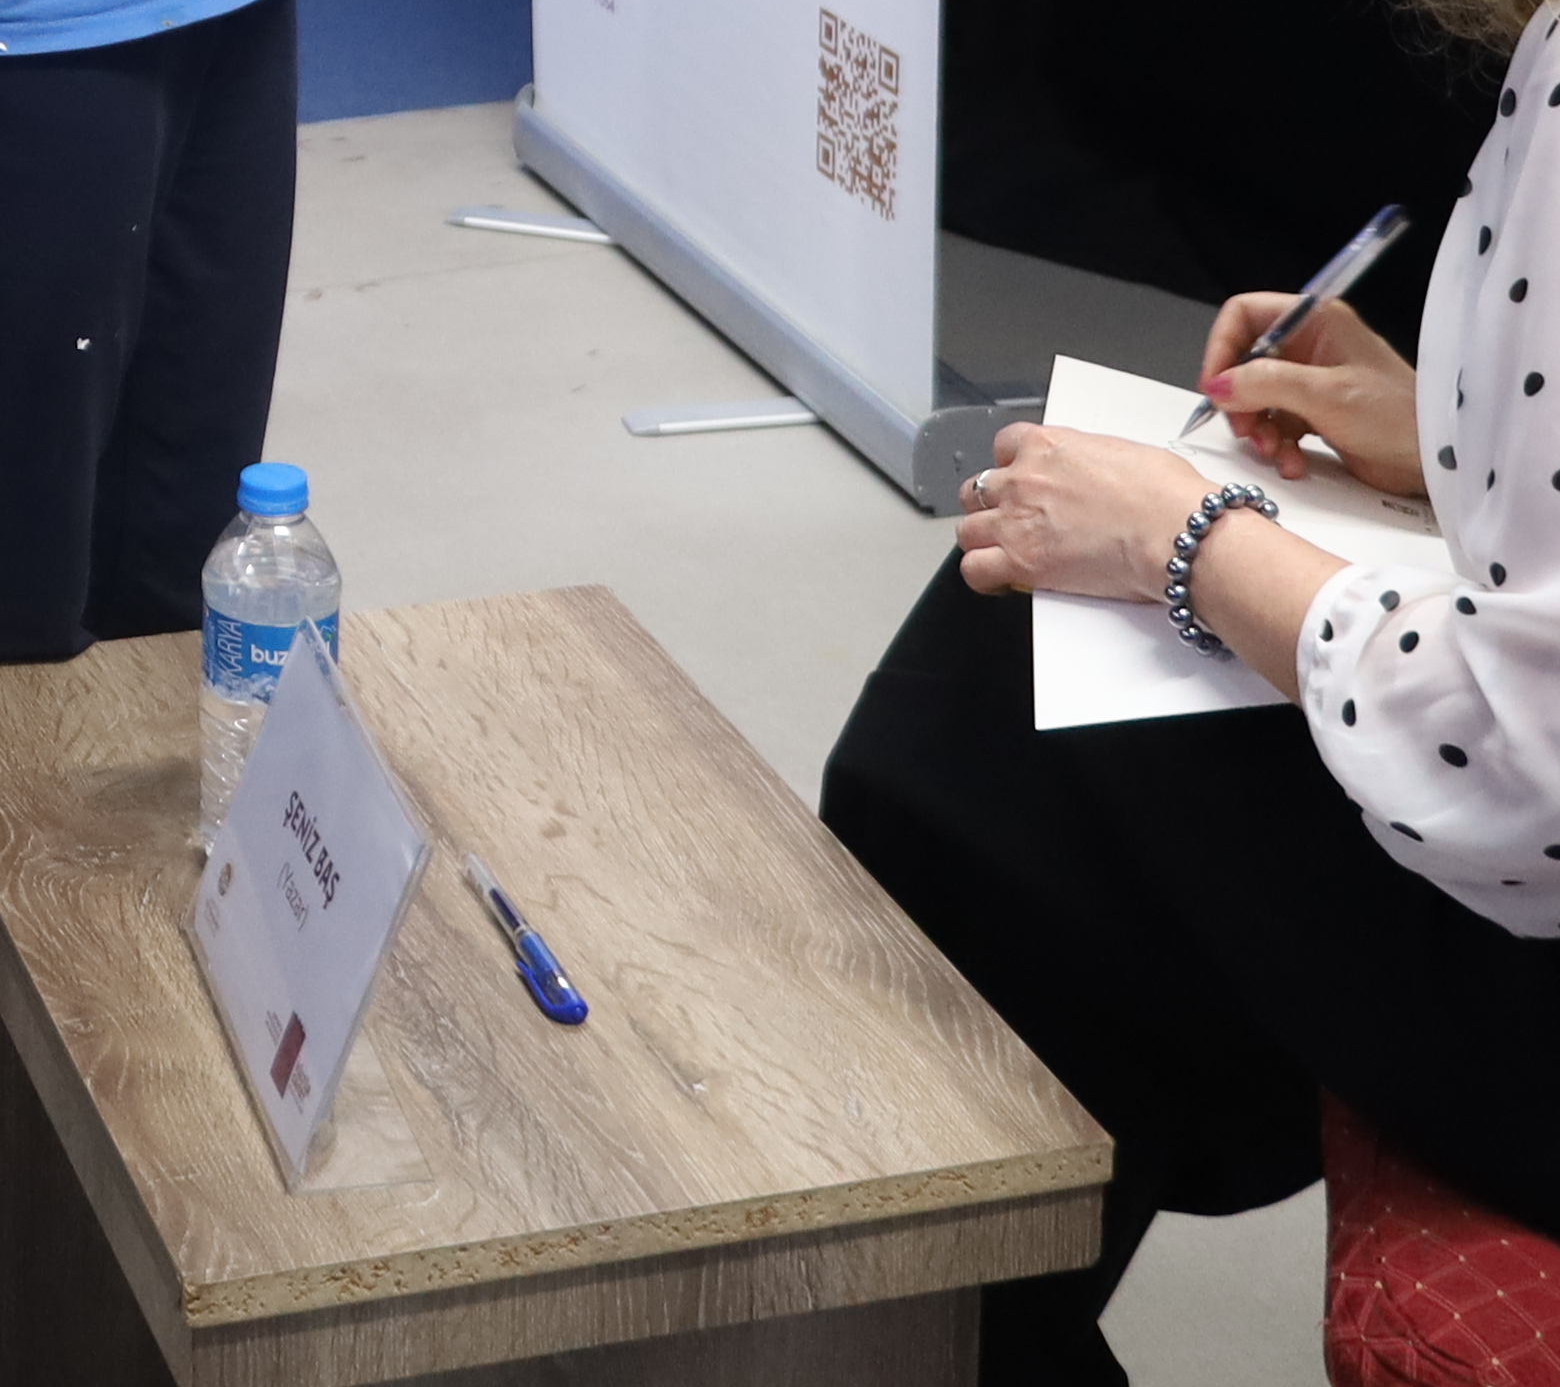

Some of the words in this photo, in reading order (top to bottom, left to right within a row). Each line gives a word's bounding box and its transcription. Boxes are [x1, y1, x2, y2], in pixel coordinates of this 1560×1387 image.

[276, 861, 310, 933] (Yazar)
[282, 790, 320, 865] ŞENİZ
[312, 846, 341, 911] BAŞ
